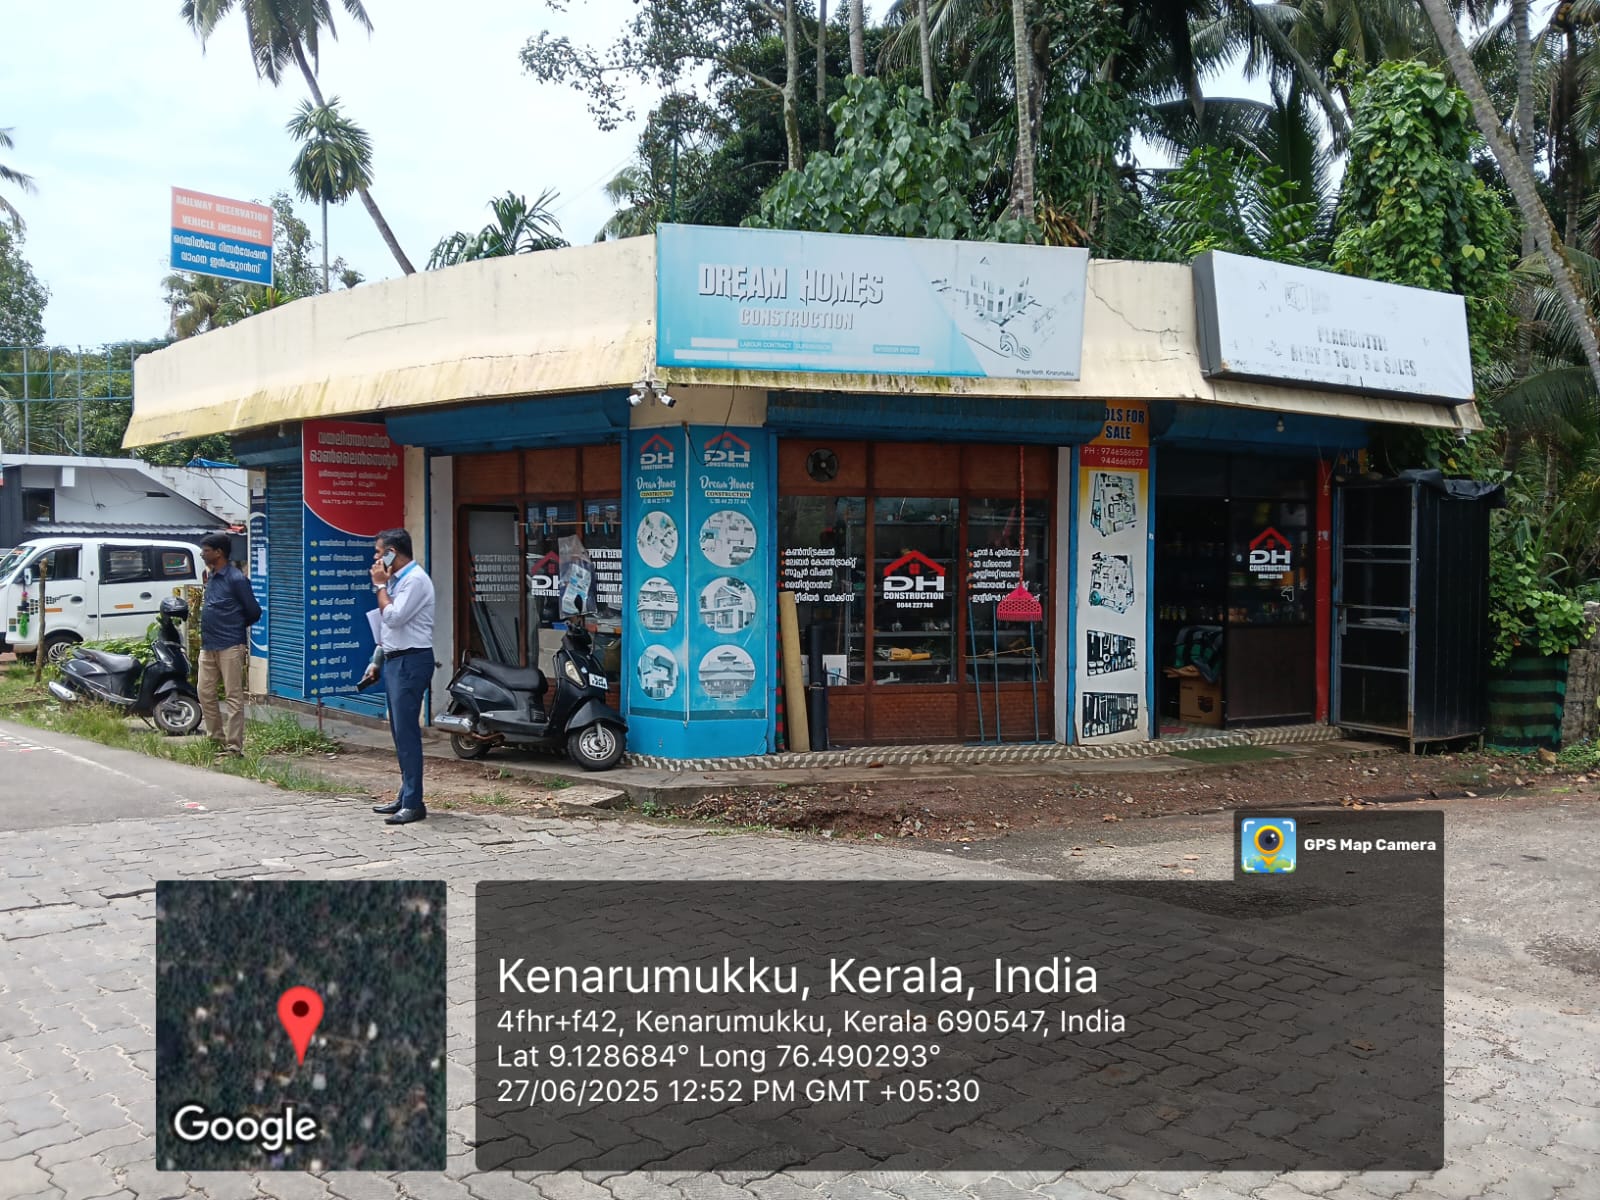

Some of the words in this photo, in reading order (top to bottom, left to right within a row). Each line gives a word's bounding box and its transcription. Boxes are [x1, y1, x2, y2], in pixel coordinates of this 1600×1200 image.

[175, 195, 213, 211] RAILWAY
[216, 203, 268, 222] RESERVATION
[182, 214, 216, 230] VEHICLE
[218, 223, 262, 239] INSURANCE
[698, 263, 788, 301] DREAM
[800, 268, 884, 307] HOMES
[739, 307, 854, 331] CONSTRUCTION
[1126, 409, 1145, 424] FOR
[1106, 425, 1131, 440] SALE
[640, 452, 674, 465] DH
[704, 449, 751, 462] DH
[636, 476, 657, 490] Dream
[657, 476, 676, 490] Homes
[699, 475, 728, 490] Dream
[728, 475, 755, 490] Homes
[1249, 549, 1291, 564] DH
[1249, 564, 1291, 572] CONSTRUCTION
[883, 576, 944, 591] DH
[597, 594, 613, 603] ERIOR
